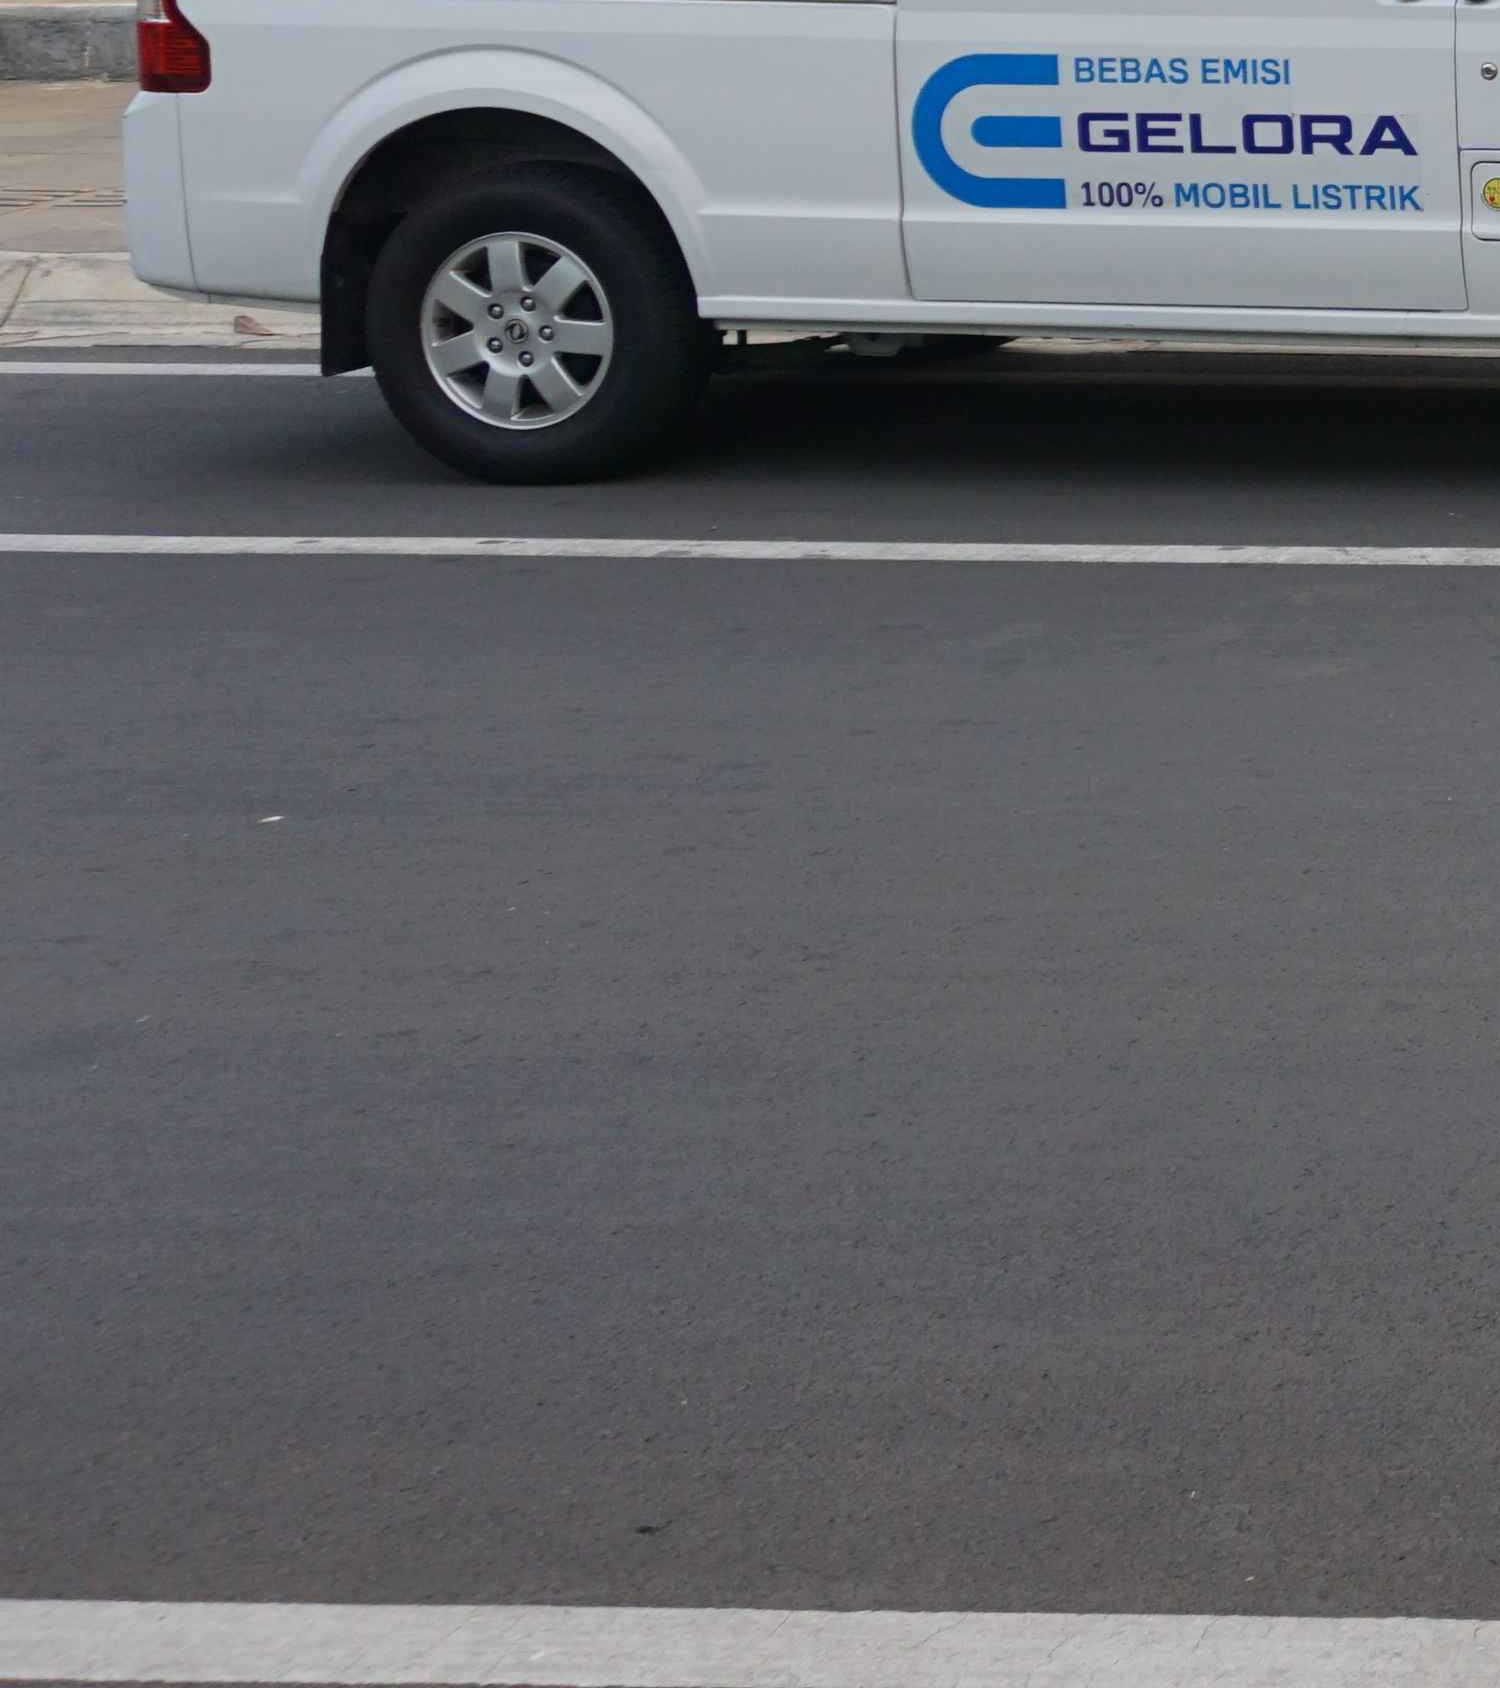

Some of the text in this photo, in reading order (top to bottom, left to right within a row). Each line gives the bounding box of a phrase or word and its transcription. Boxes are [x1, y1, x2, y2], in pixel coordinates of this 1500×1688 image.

[1073, 57, 1291, 86] BEBAS EMISI
[1076, 112, 1418, 156] GELORA
[1081, 181, 1424, 212] 100% MOBIL LISTRIK
